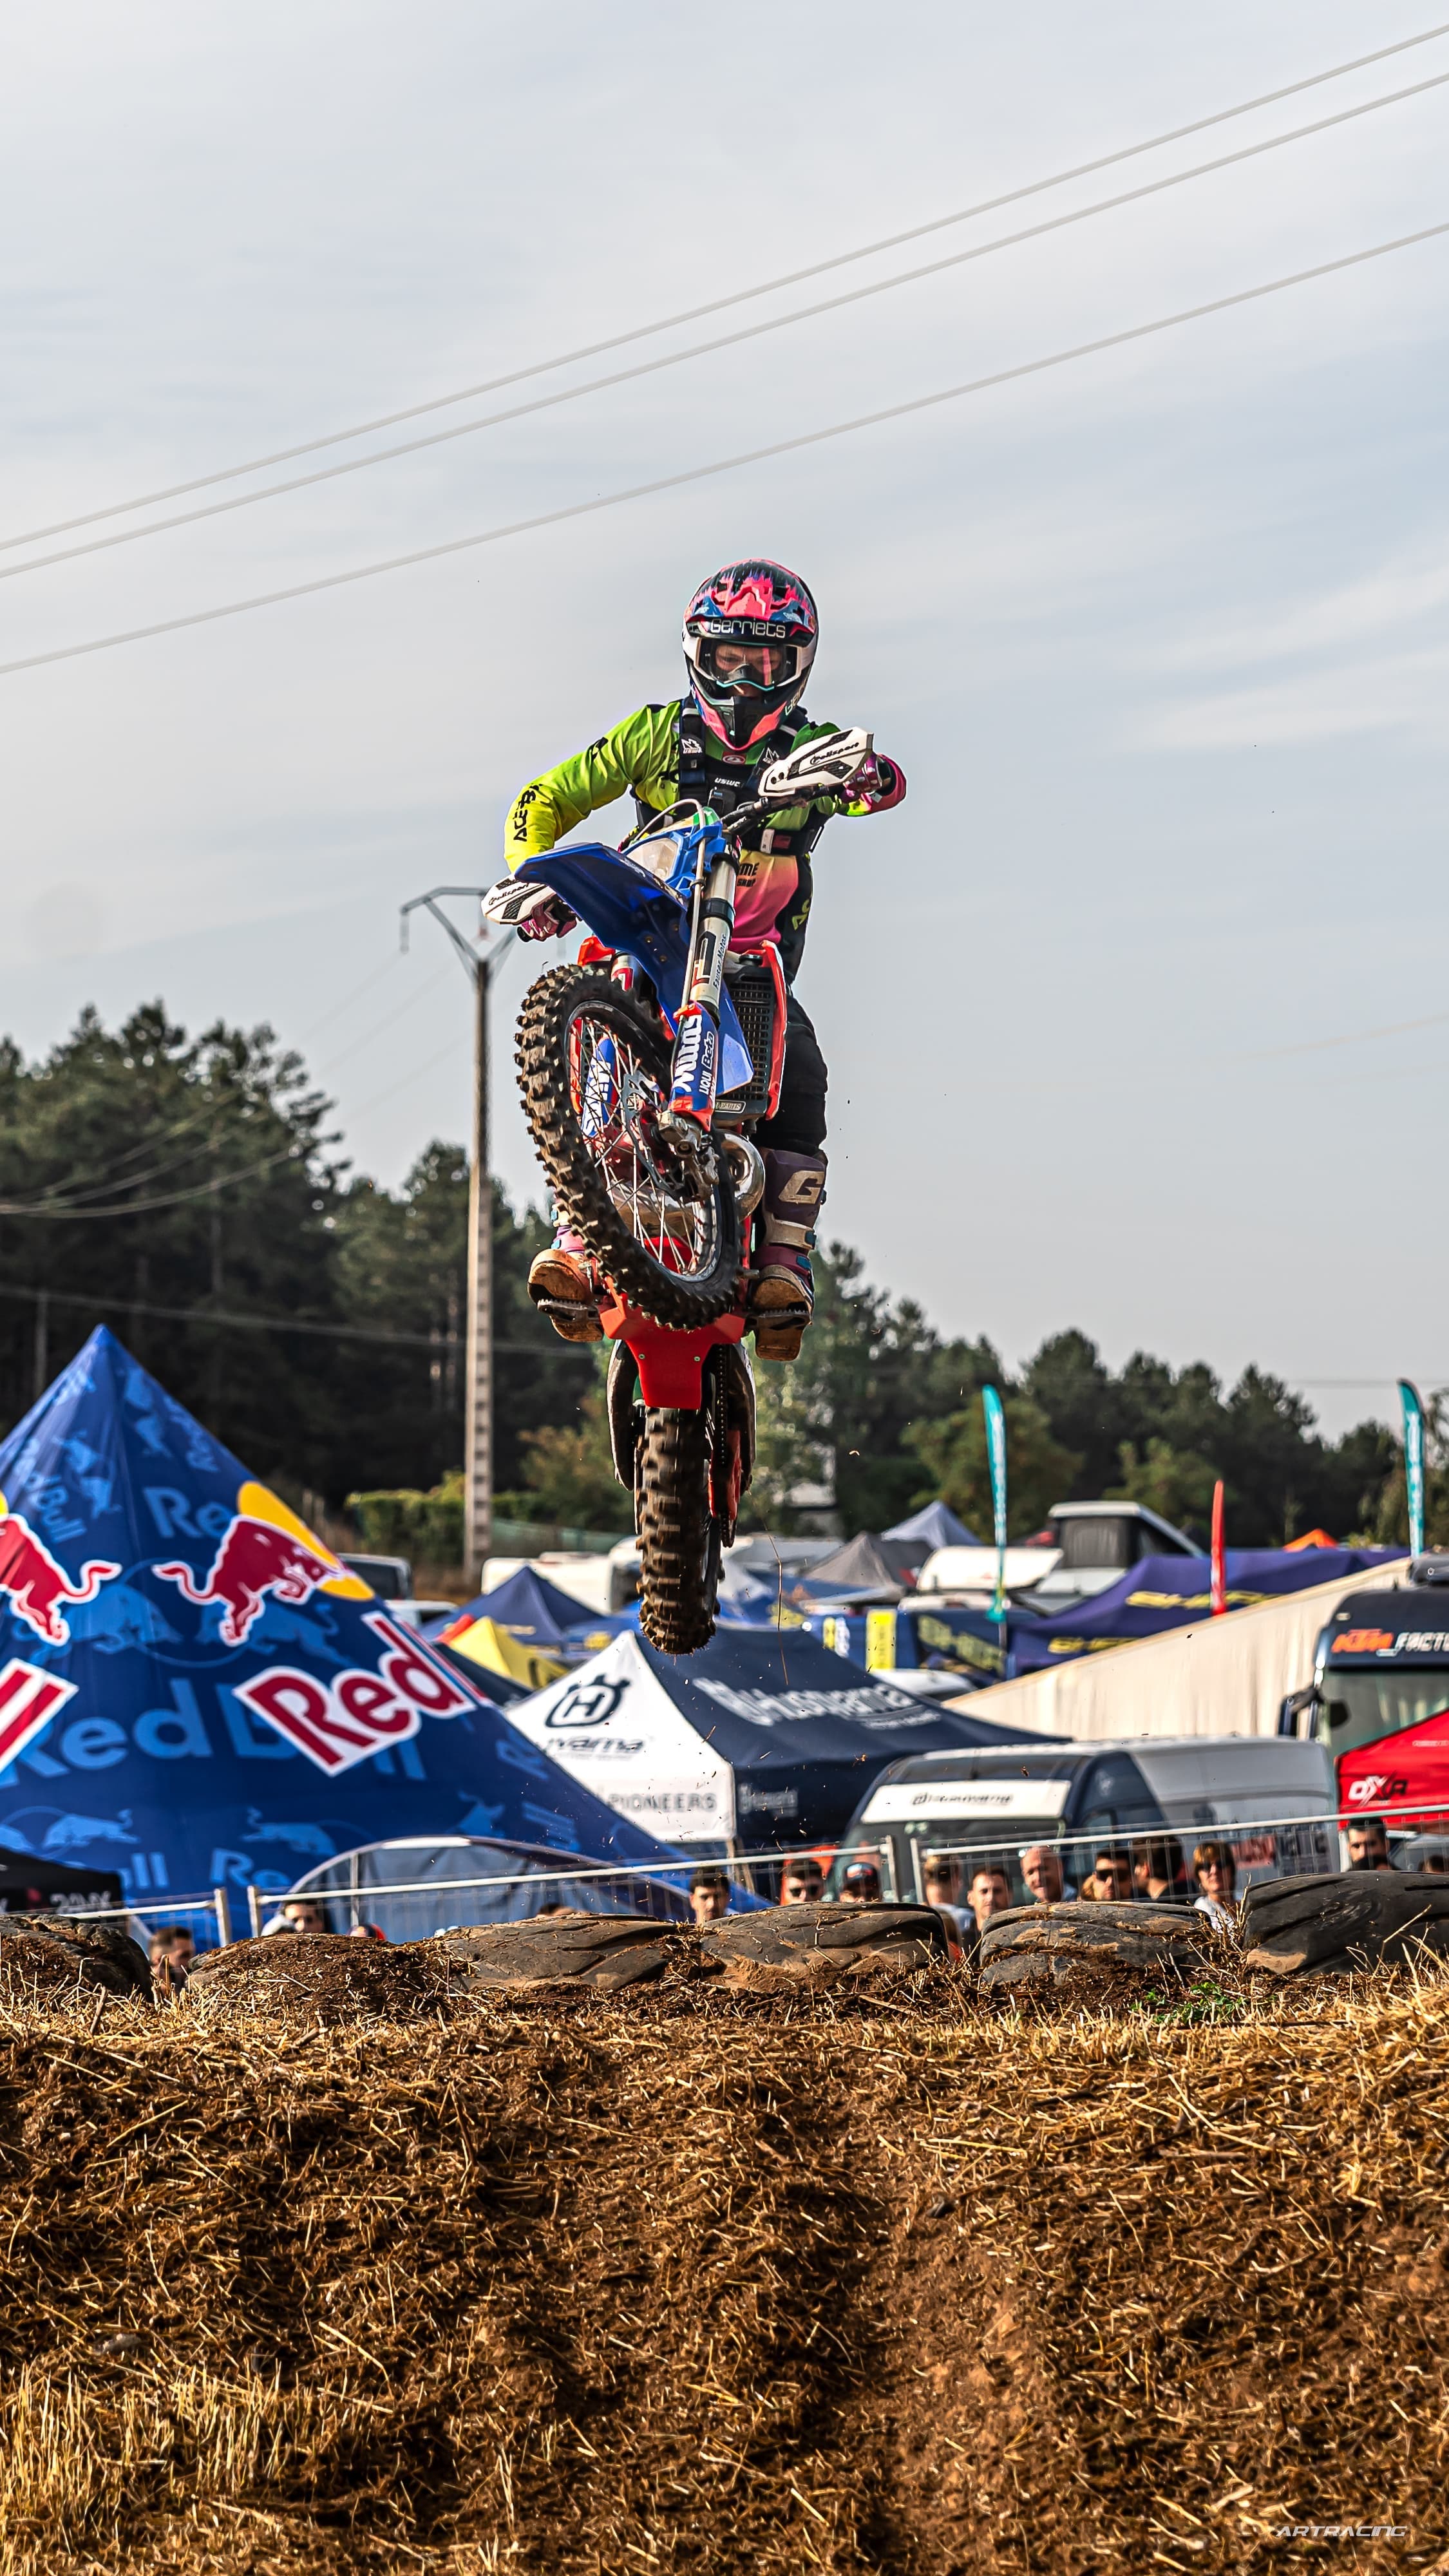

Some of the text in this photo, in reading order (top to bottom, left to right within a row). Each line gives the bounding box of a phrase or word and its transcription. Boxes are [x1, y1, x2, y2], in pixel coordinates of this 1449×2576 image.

[710, 618, 786, 639] Gerriets
[810, 741, 860, 765] Polisport
[701, 1031, 715, 1070] Beta
[699, 1070, 712, 1095] LIQUI
[1331, 1629, 1394, 1653] KTM
[235, 1612, 477, 1776] Red
